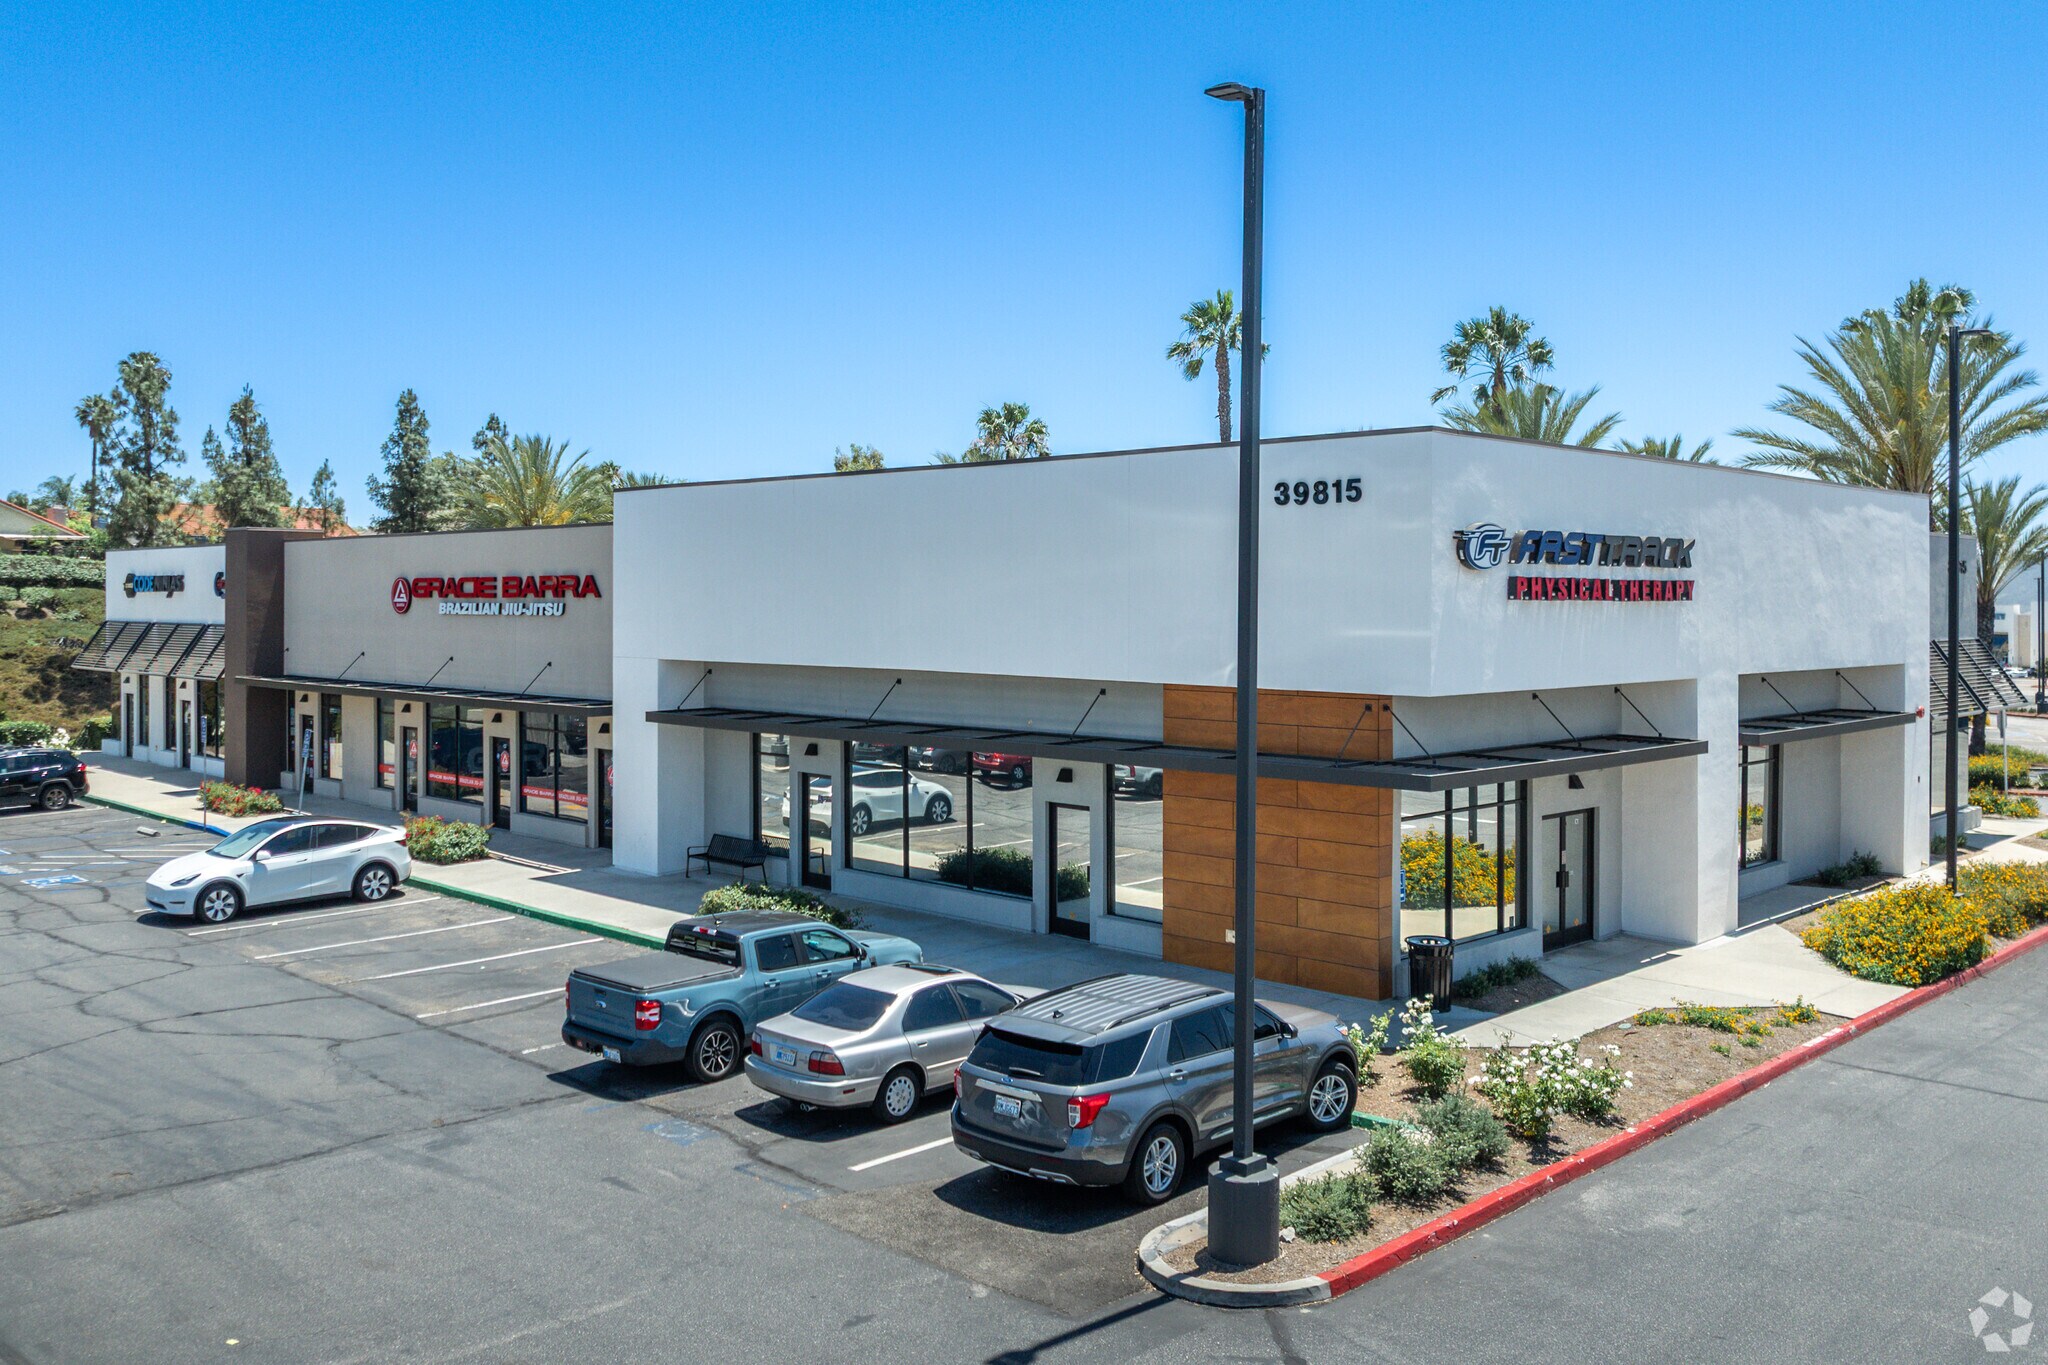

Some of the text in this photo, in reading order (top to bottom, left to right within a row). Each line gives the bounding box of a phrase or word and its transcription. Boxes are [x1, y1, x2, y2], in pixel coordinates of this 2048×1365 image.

[1273, 478, 1363, 506] 39815
[411, 575, 601, 599] GRACIE BARRA
[1516, 576, 1695, 601] PHYSICAL THERAPY
[438, 602, 564, 616] BRAZILIAN JIU-JITSU
